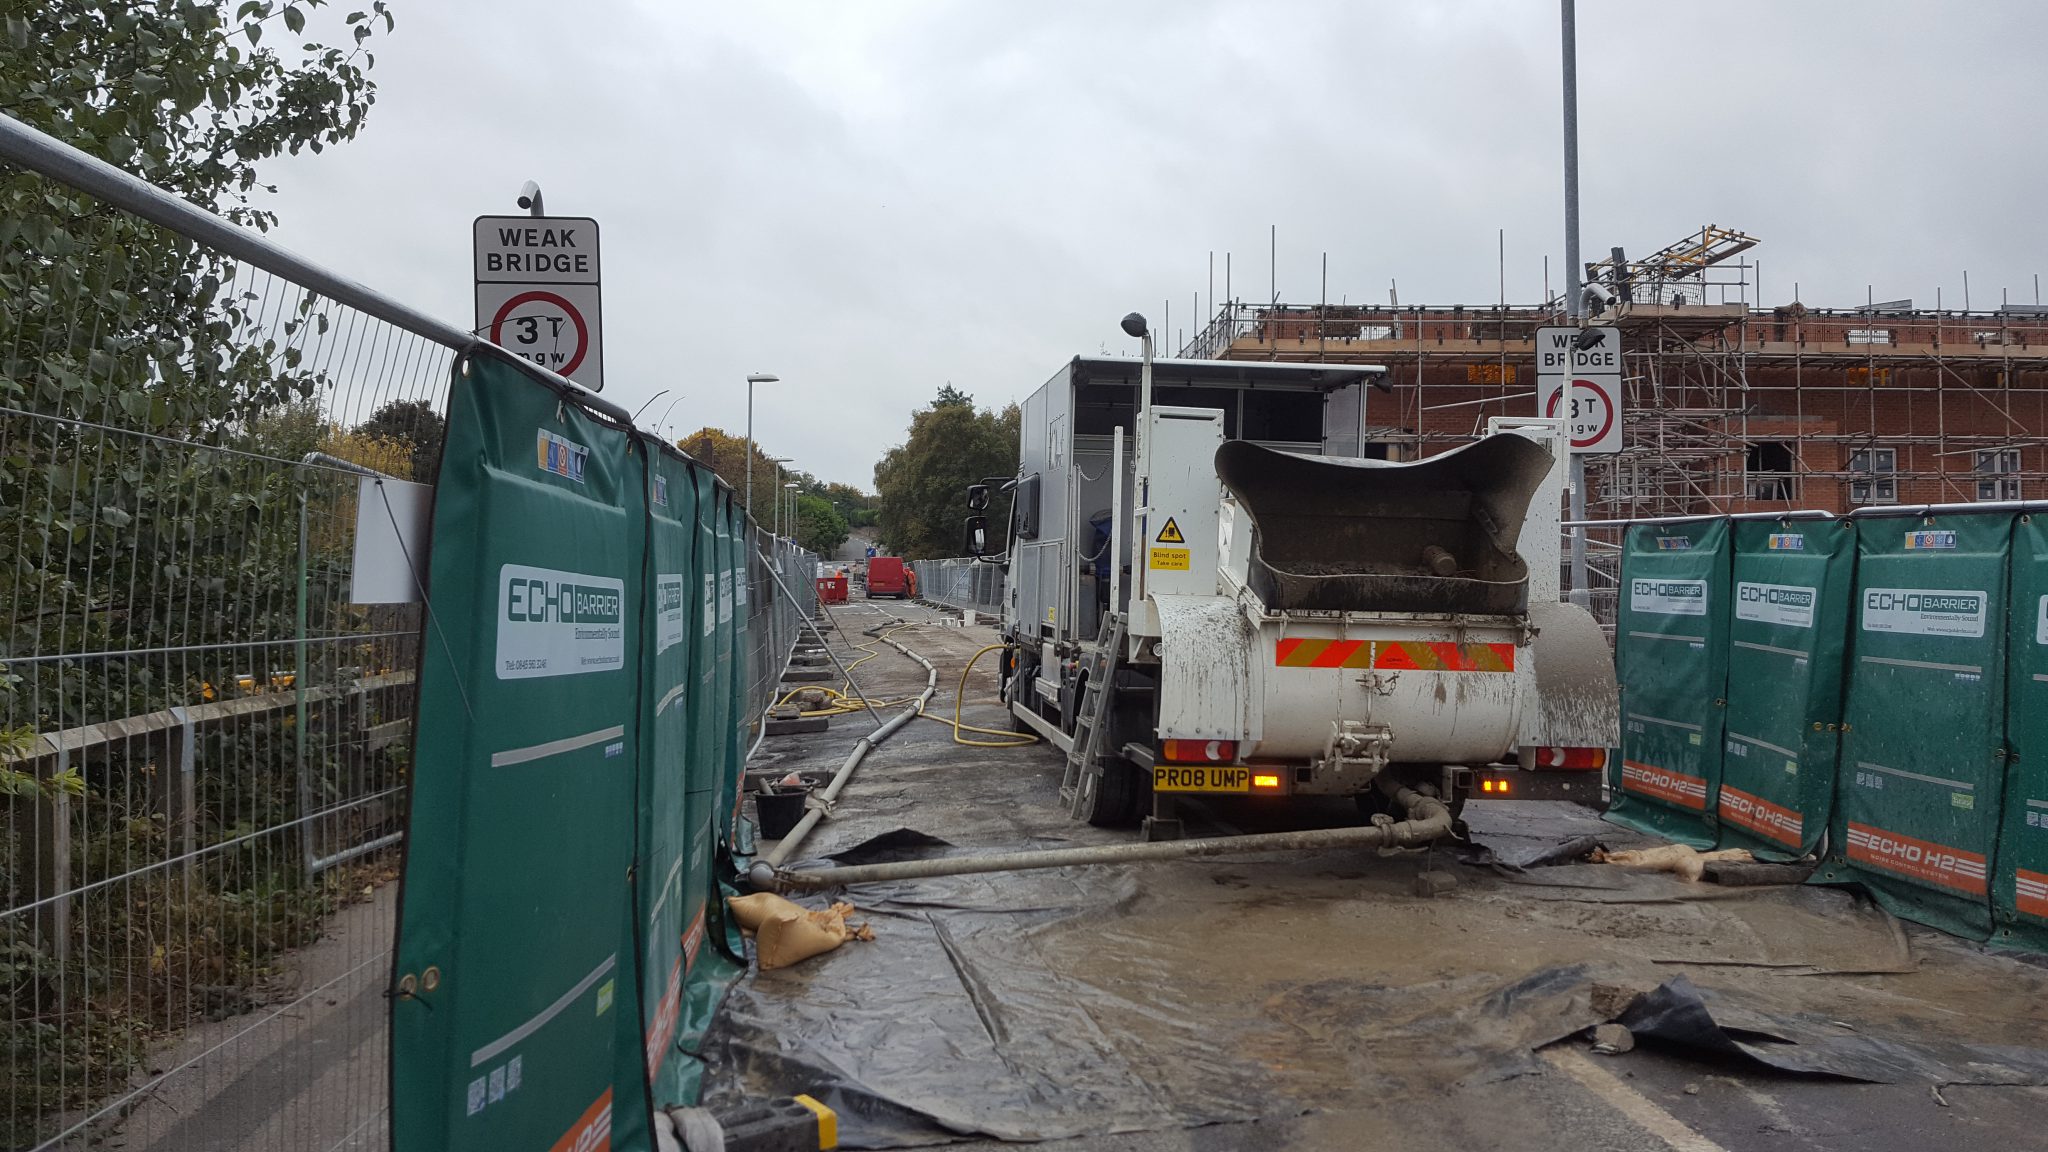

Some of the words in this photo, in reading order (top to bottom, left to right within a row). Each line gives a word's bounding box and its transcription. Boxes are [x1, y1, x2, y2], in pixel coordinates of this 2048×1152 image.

[498, 227, 577, 249] WEAK
[487, 253, 589, 274] BRIDGE
[1544, 352, 1614, 367] BRDGE
[1634, 582, 1667, 597] ECHO
[1668, 585, 1701, 595] BARRIER
[1740, 586, 1779, 605] ECHO
[1779, 592, 1811, 605] BARRIER
[508, 577, 575, 624] ECHO
[577, 592, 619, 616] BARRIER
[1867, 592, 1921, 612] ECHO
[1923, 598, 1977, 611] BARRIER
[1154, 768, 1206, 787] PR08
[1210, 770, 1248, 788] UMP
[1634, 769, 1670, 788] ECHO
[1670, 778, 1688, 793] H2
[1764, 809, 1783, 828] H2
[1867, 834, 1922, 862] ECHO
[1924, 850, 1955, 872] H2
